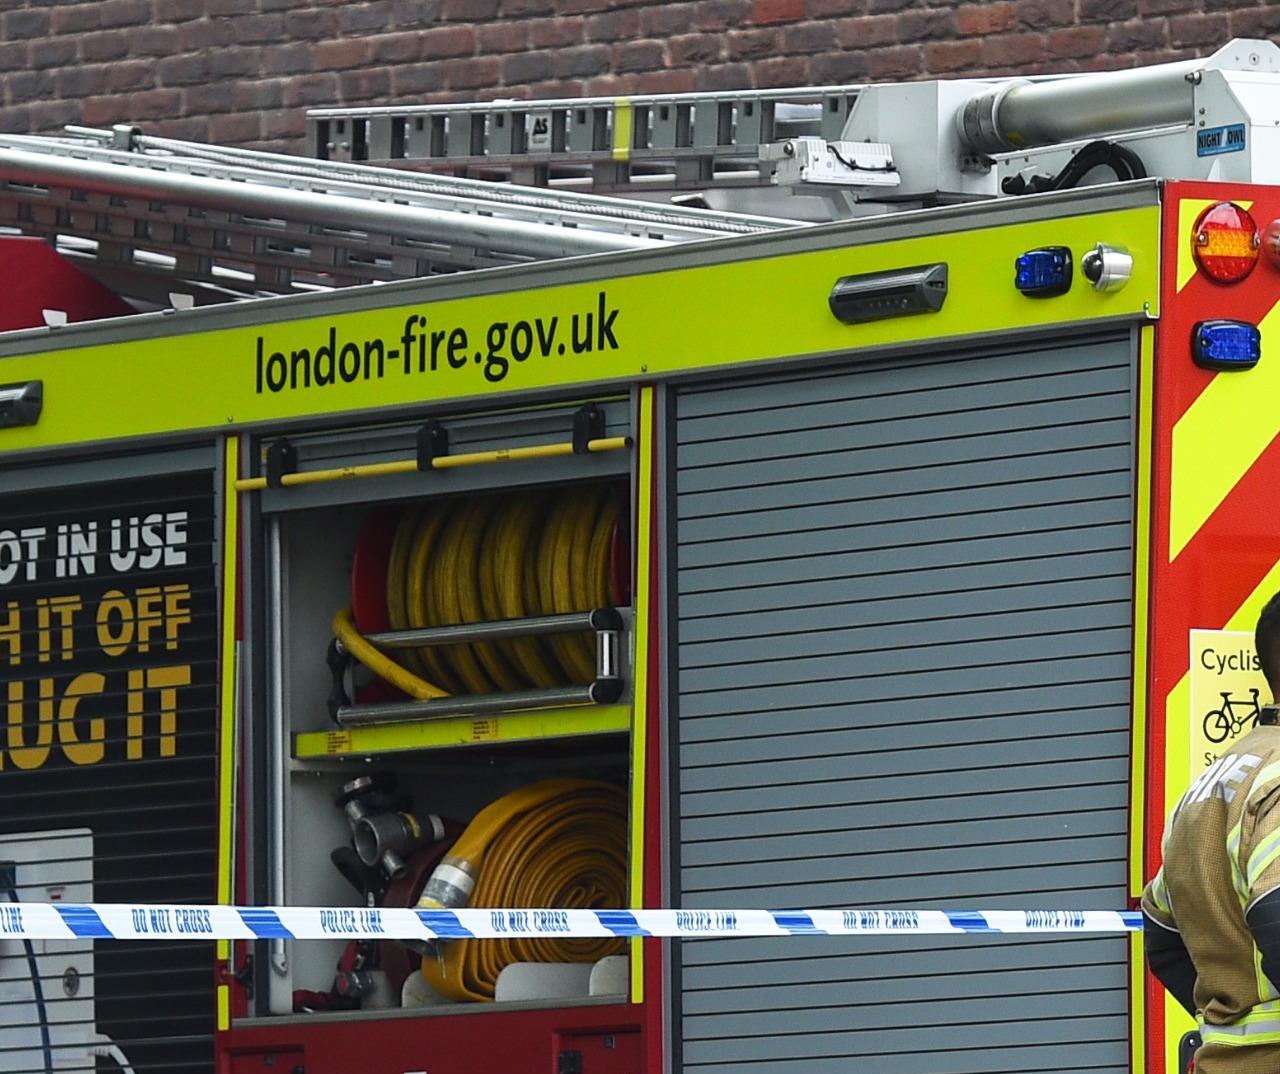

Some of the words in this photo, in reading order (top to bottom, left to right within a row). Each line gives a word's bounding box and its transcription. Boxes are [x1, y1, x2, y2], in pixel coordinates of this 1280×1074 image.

[1198, 133, 1220, 149] NIGHT
[1226, 130, 1245, 145] OWL
[256, 292, 620, 394] london-fire.gov.uk
[56, 522, 97, 577] IN
[110, 511, 188, 572] USE
[37, 595, 82, 662] IT
[97, 584, 192, 657] OFF
[1201, 648, 1261, 675] Cyclis
[127, 665, 192, 760] IT
[132, 908, 148, 933] DO
[150, 908, 172, 933] NOT
[175, 909, 213, 934] CROSS
[320, 910, 357, 933] POLICE
[359, 911, 386, 933] LINE
[491, 911, 506, 932] DO
[508, 911, 530, 932] NOT
[533, 911, 571, 933] CROSS
